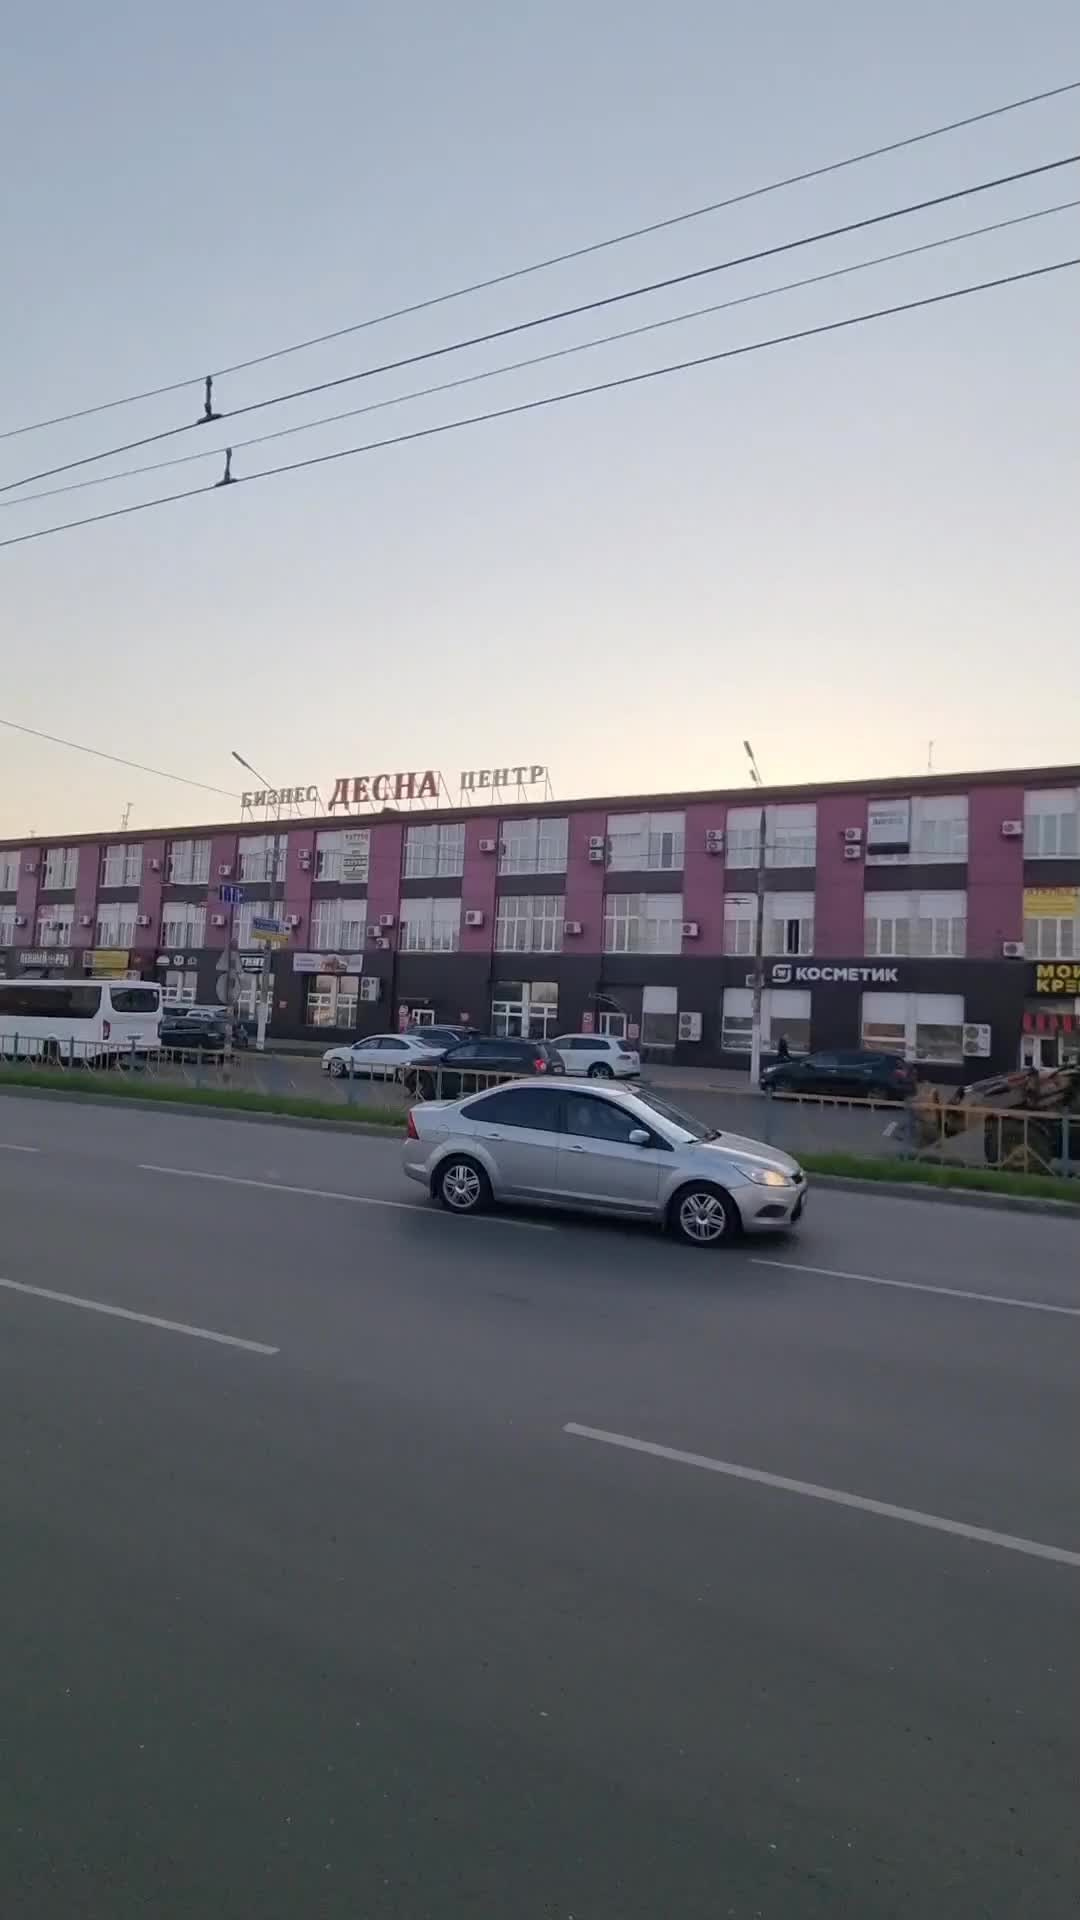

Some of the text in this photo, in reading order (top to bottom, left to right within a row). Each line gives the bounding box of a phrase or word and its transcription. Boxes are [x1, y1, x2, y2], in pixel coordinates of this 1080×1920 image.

[240, 766, 545, 811] БИЗНЕС ДЕСНА ЦЕНТР
[796, 967, 898, 982] КОСМЕТИК
[1036, 979, 1080, 993] КРЕ
